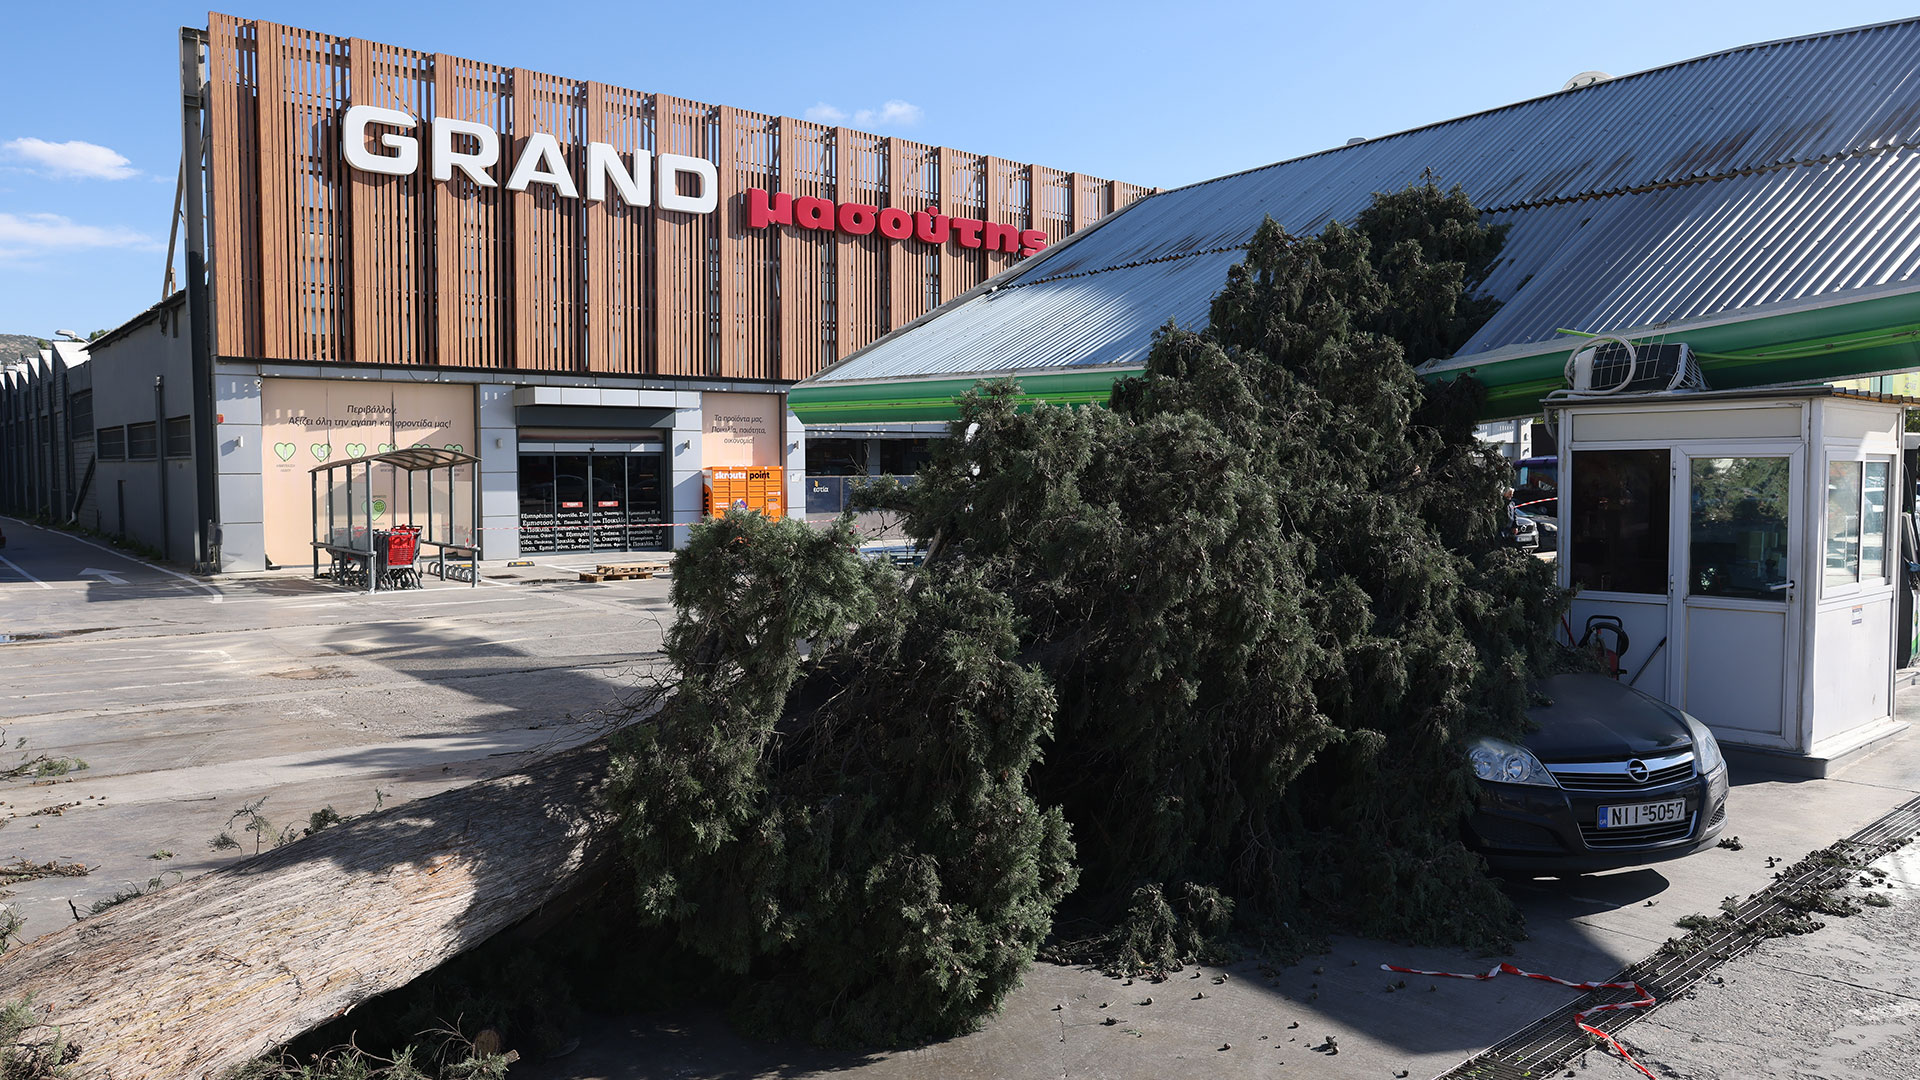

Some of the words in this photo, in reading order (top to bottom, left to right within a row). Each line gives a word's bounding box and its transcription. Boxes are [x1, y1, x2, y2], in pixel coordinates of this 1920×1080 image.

[342, 105, 718, 214] GRAND
[746, 187, 1049, 257] μασούτης
[288, 416, 313, 426] Αξίζει
[316, 417, 332, 426] όλη
[351, 418, 377, 427] αγάπη
[395, 419, 432, 428] φροντίδα
[434, 420, 452, 428] μας!
[714, 414, 722, 422] Τα
[723, 415, 750, 423] προϊόντα
[749, 471, 770, 480] point
